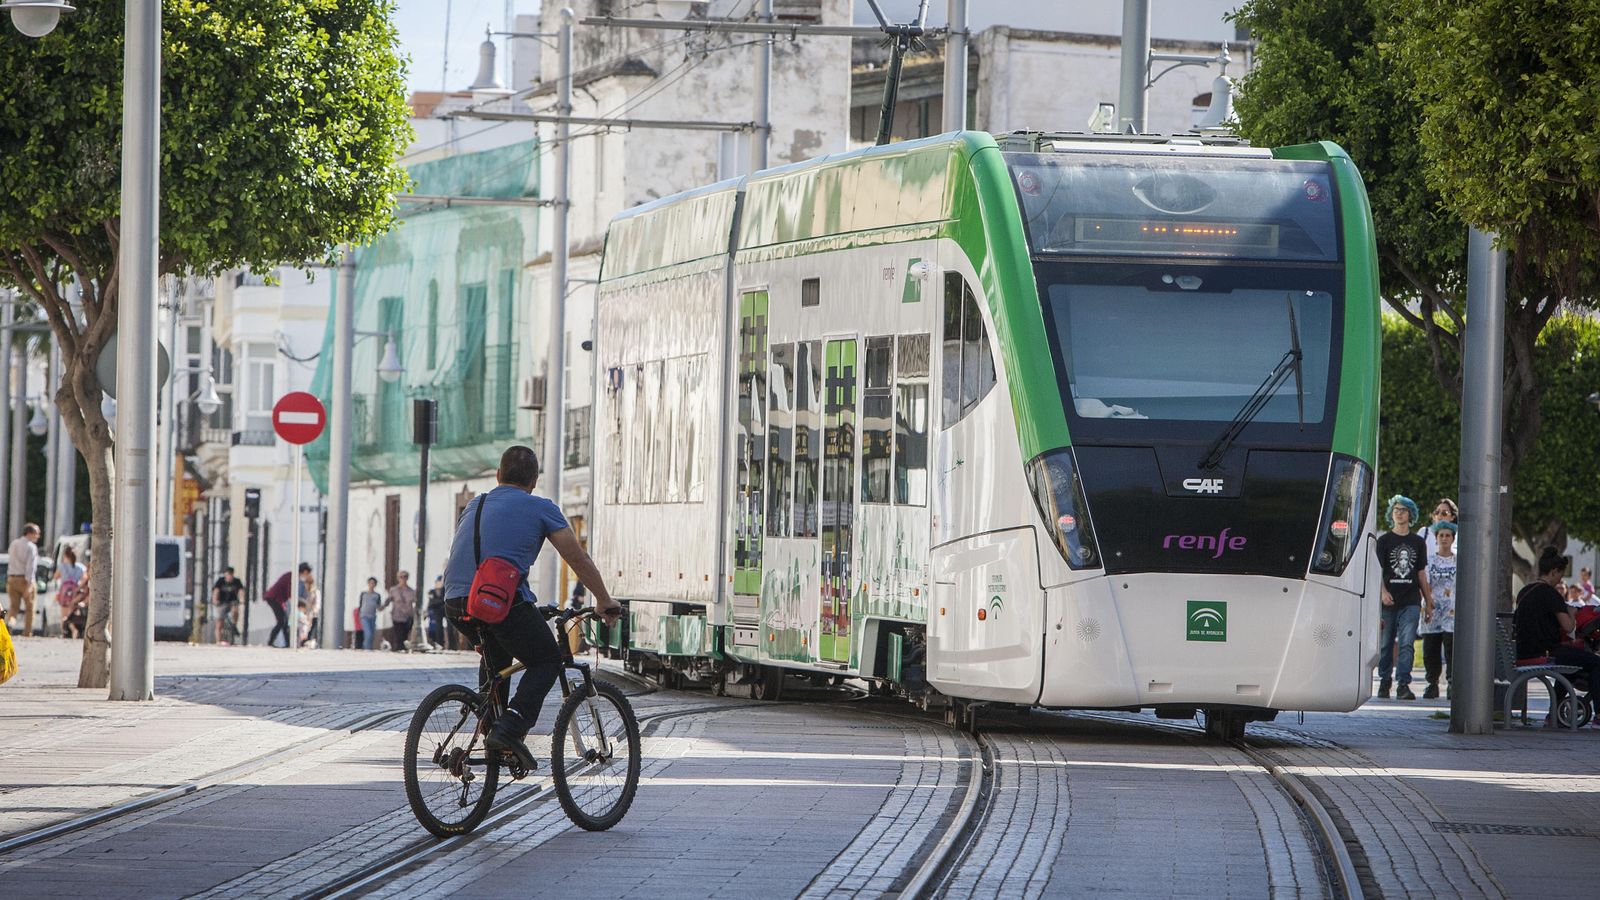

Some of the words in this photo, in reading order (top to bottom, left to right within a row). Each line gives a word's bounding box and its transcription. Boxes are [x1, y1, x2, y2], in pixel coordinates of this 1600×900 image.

[883, 258, 895, 288] renfe
[1182, 478, 1225, 494] CAF
[1163, 527, 1247, 560] renfe
